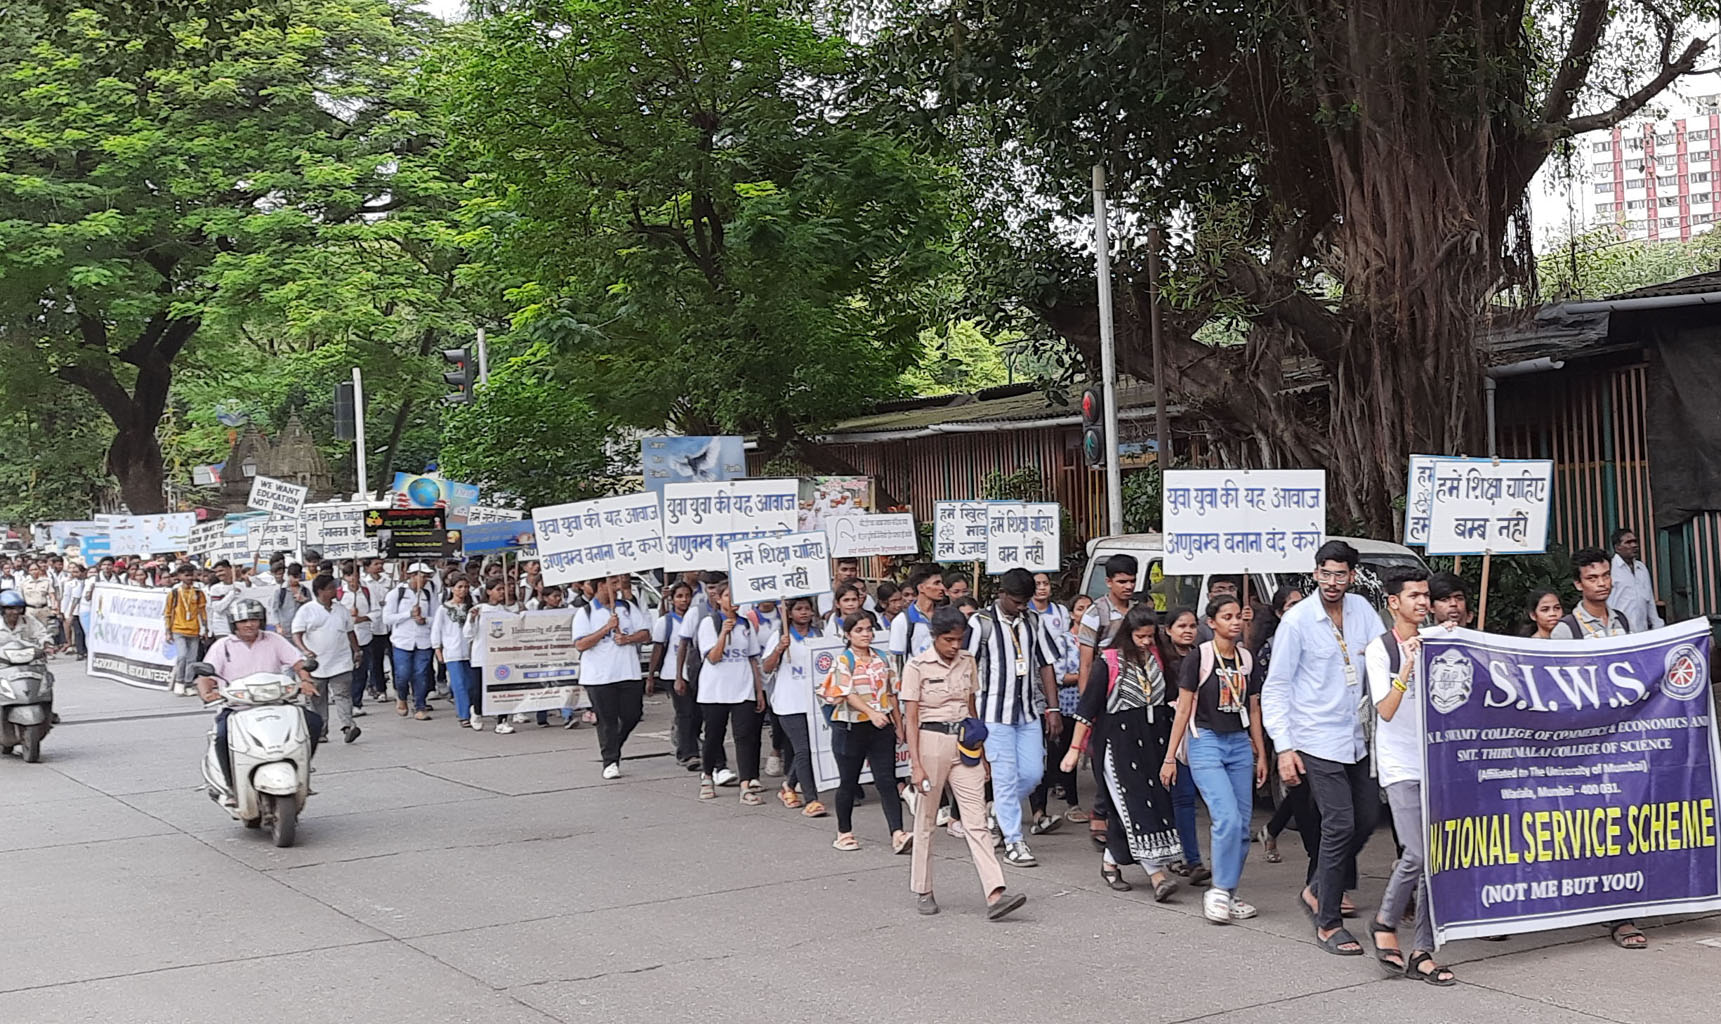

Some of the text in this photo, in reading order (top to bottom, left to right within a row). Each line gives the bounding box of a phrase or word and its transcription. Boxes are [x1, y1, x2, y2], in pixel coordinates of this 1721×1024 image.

[256, 489, 299, 505] EDUCATION
[261, 480, 300, 496] WE WANT
[1167, 479, 1321, 516] युवा युवा की यह आवाज
[1436, 468, 1546, 506] हमें शिक्षा चाहिए
[252, 497, 295, 513] NOT BOMB
[666, 490, 796, 524] युवा युवा की यह आवाज
[940, 504, 956, 522] हमें
[537, 519, 560, 541] युवा
[561, 515, 582, 537] युवा
[583, 508, 601, 528] की
[603, 510, 624, 527] यह
[625, 505, 659, 524] आवाज
[991, 510, 1005, 537] हमें
[1007, 509, 1028, 538] शिक्षा
[1030, 509, 1054, 536] चाहिए
[1292, 522, 1321, 551] करो
[1454, 511, 1529, 542] बम्ब नहीं
[636, 529, 663, 553] करो
[733, 546, 753, 570] हमें
[759, 543, 790, 567] शिक्षा
[792, 539, 826, 561] चाहिए
[1024, 541, 1045, 565] नहीं
[749, 567, 809, 592] बम्ब नहीं
[1483, 660, 1650, 711] S.I.W.S.
[1481, 728, 1533, 741] COLLEGE
[1534, 731, 1553, 741] OF
[1618, 717, 1688, 733] ECONOMICS
[1457, 749, 1479, 761] SMT.
[1551, 743, 1600, 757] COLLEGE
[1601, 742, 1619, 754] OF
[1620, 738, 1672, 752] SCIENCE
[1529, 766, 1546, 777] The
[1591, 764, 1602, 774] of
[1581, 785, 1599, 795] 400
[1430, 799, 1716, 876] NATIONAL SERVICE SCHEME
[1481, 871, 1644, 907] (NOT ME BUT YOU)
